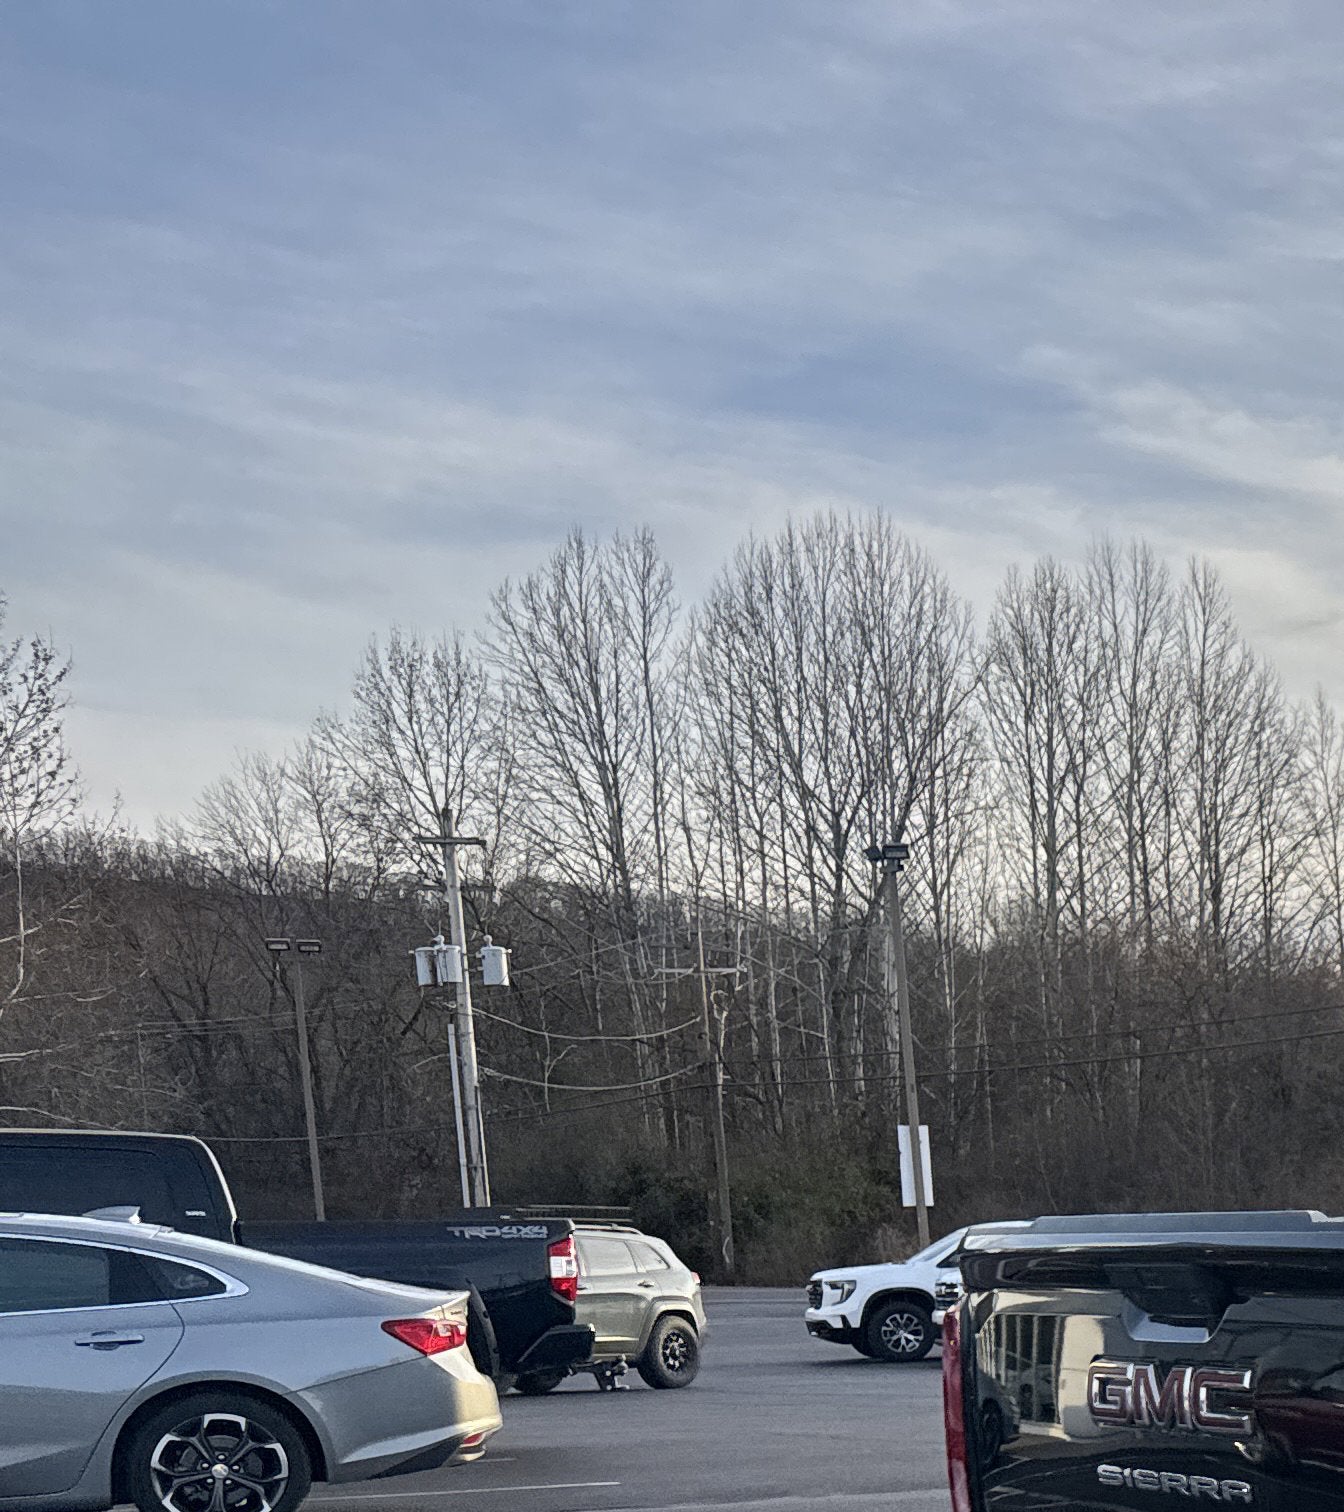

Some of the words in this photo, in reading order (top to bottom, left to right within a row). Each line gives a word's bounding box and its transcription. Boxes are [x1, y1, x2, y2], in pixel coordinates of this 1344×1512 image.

[446, 1225, 501, 1239] TRD
[1087, 1360, 1252, 1435] GMC
[1097, 1463, 1253, 1503] SIERRA
